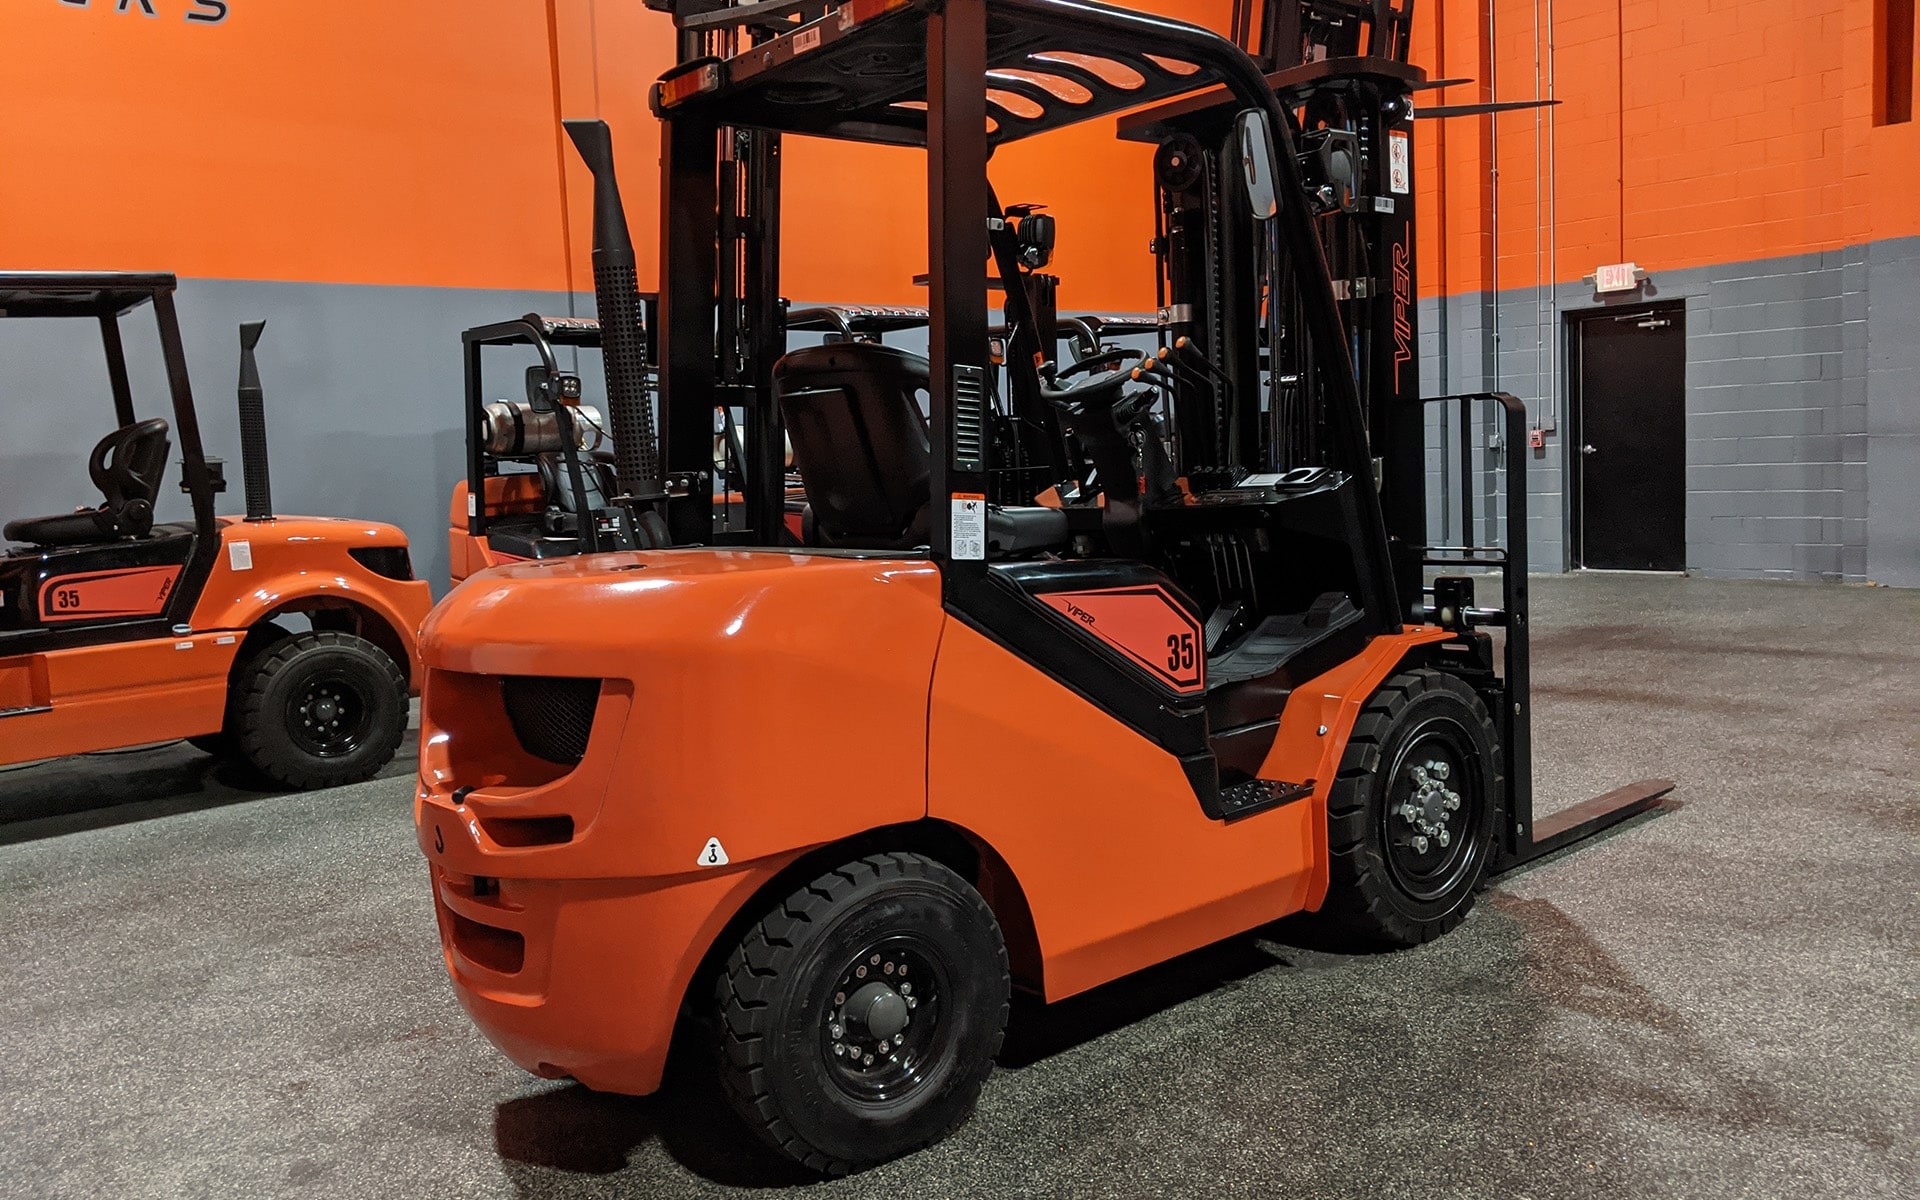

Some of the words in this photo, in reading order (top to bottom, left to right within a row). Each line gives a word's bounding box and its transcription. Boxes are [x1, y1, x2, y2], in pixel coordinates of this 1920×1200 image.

[1604, 266, 1630, 287] EXIT
[1394, 221, 1411, 393] VIPER
[58, 590, 79, 607] 35
[157, 577, 172, 602] VIPER
[1065, 602, 1096, 626] VIPER
[1168, 634, 1193, 671] 35
